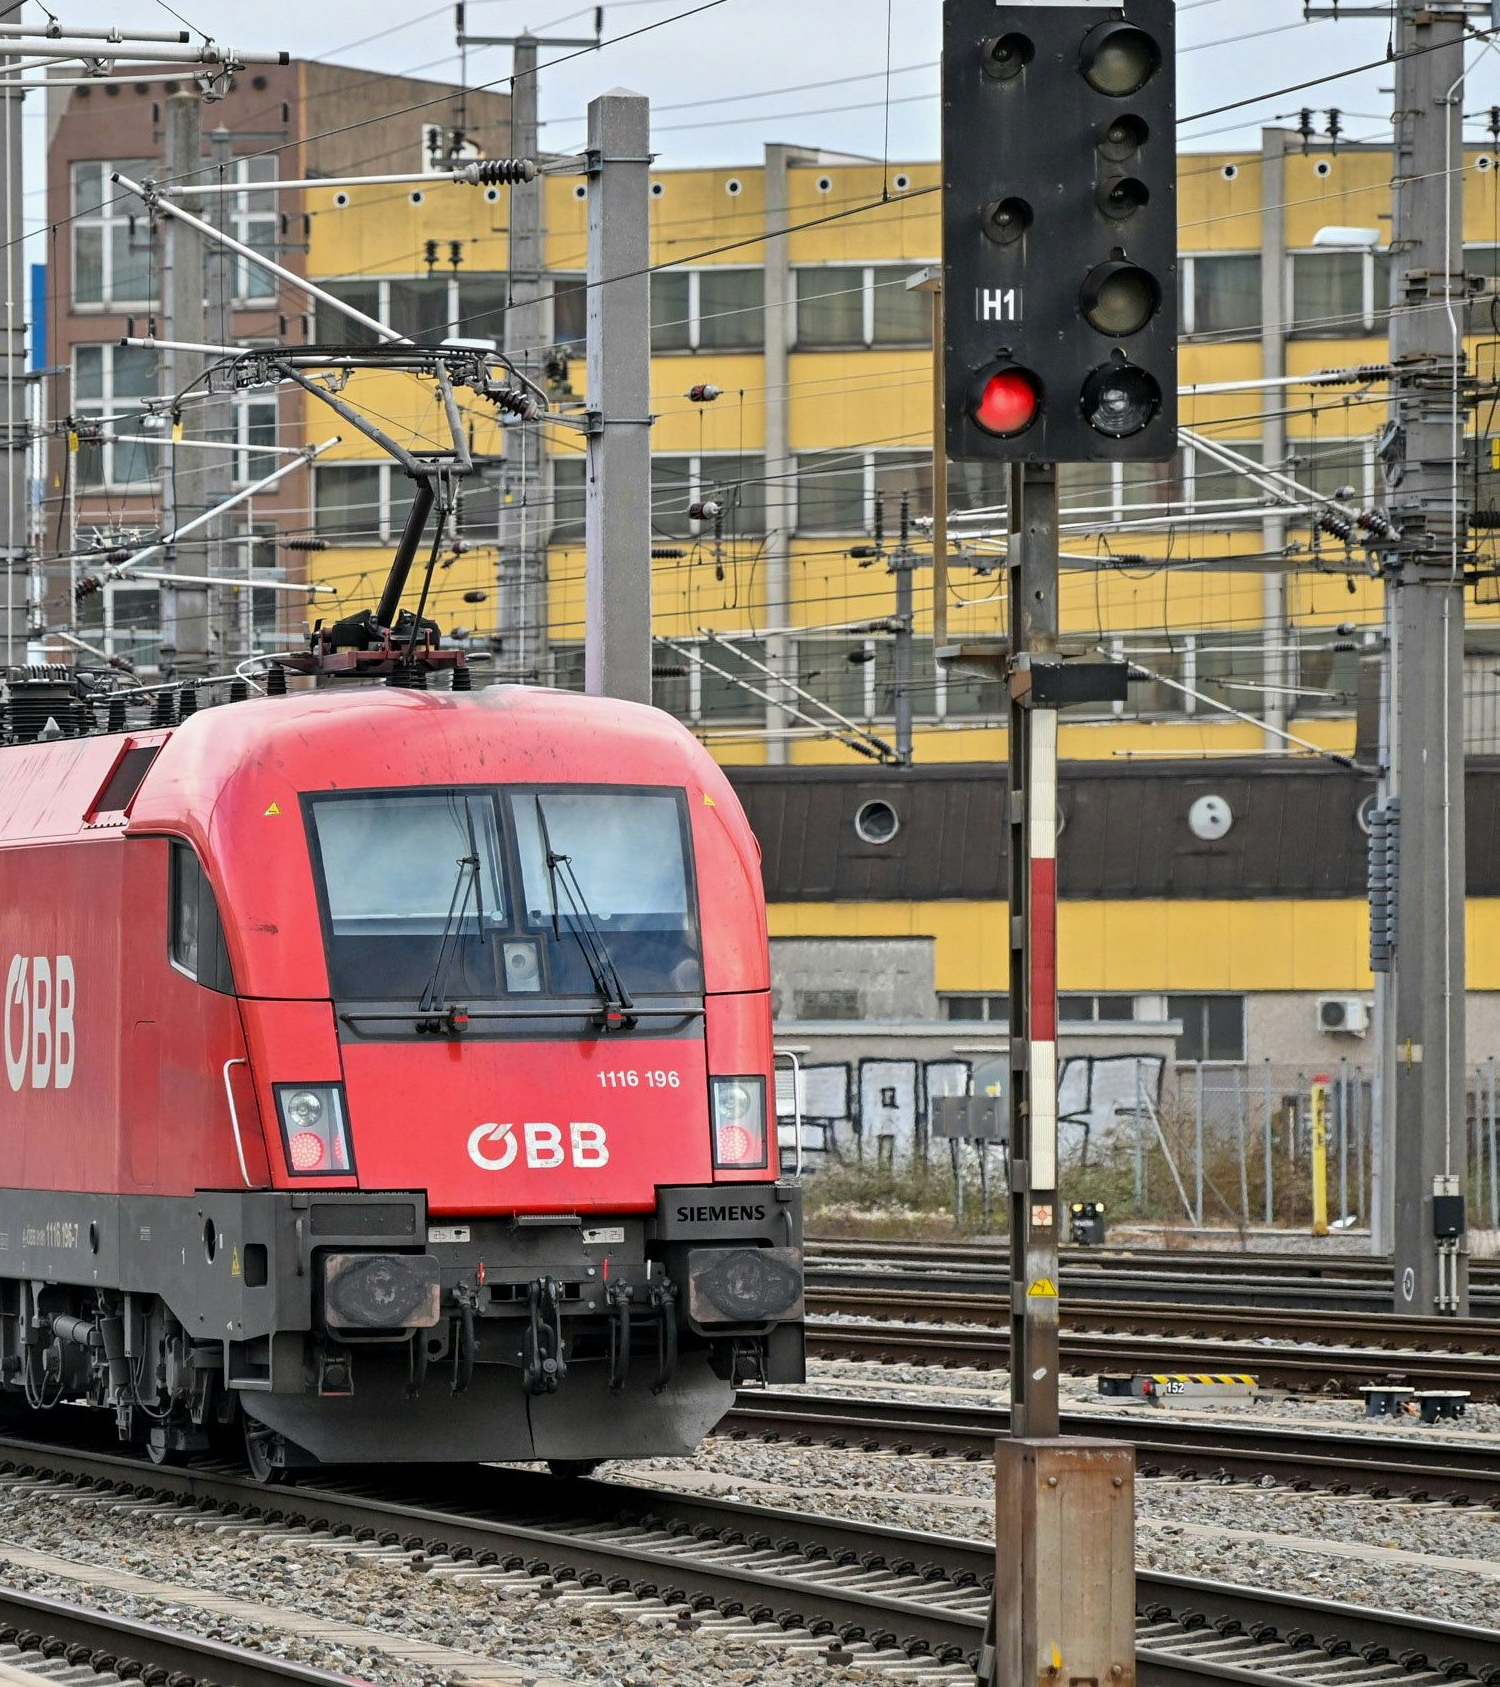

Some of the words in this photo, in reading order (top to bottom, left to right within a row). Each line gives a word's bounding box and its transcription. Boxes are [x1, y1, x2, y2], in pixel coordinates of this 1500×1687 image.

[982, 288, 1015, 322] H1
[4, 953, 76, 1092] ÖBB
[597, 1070, 639, 1088] 1116
[645, 1070, 680, 1088] 196
[467, 1120, 610, 1171] ÖBB
[676, 1204, 766, 1222] SIEMENS
[46, 1221, 61, 1247] 1116
[1166, 1382, 1185, 1394] 152
